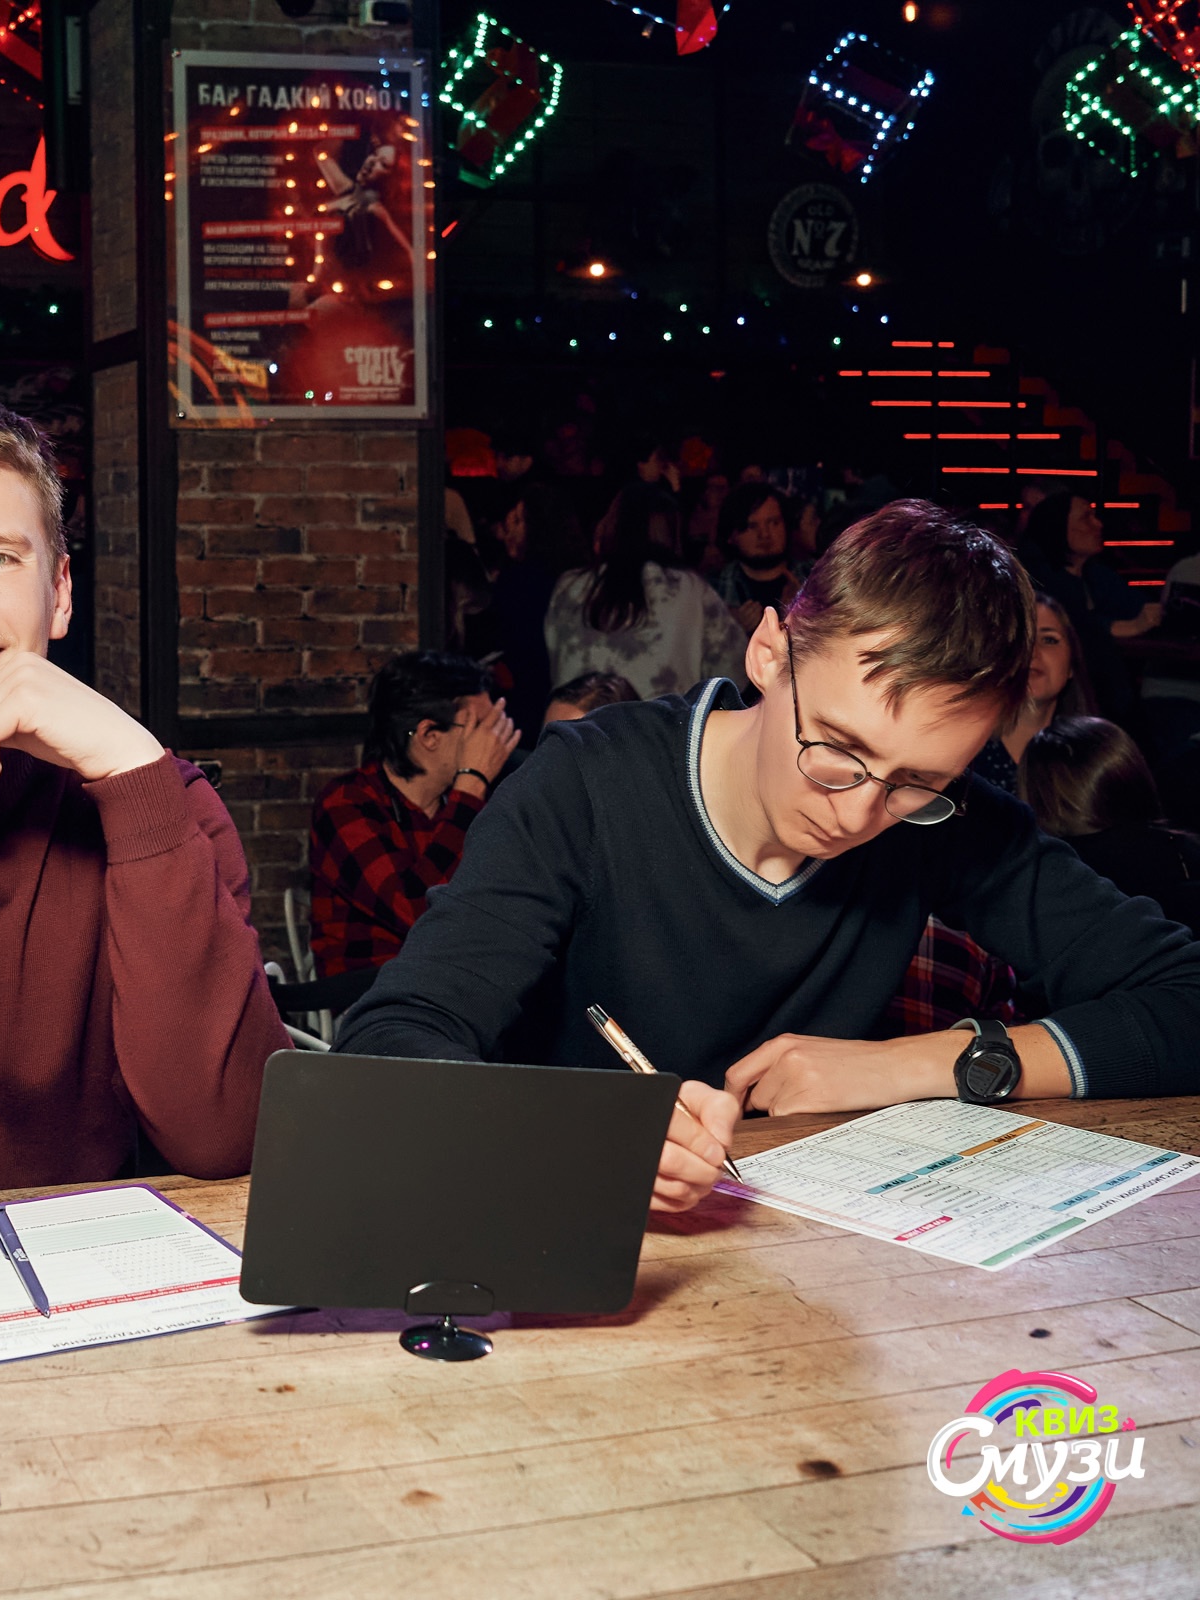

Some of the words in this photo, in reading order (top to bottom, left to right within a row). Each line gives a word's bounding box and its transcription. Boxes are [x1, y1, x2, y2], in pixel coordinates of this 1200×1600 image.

[198, 83, 238, 107] БАР
[246, 84, 331, 110] ГАДКИЙ
[338, 83, 402, 112] КОЙОТ
